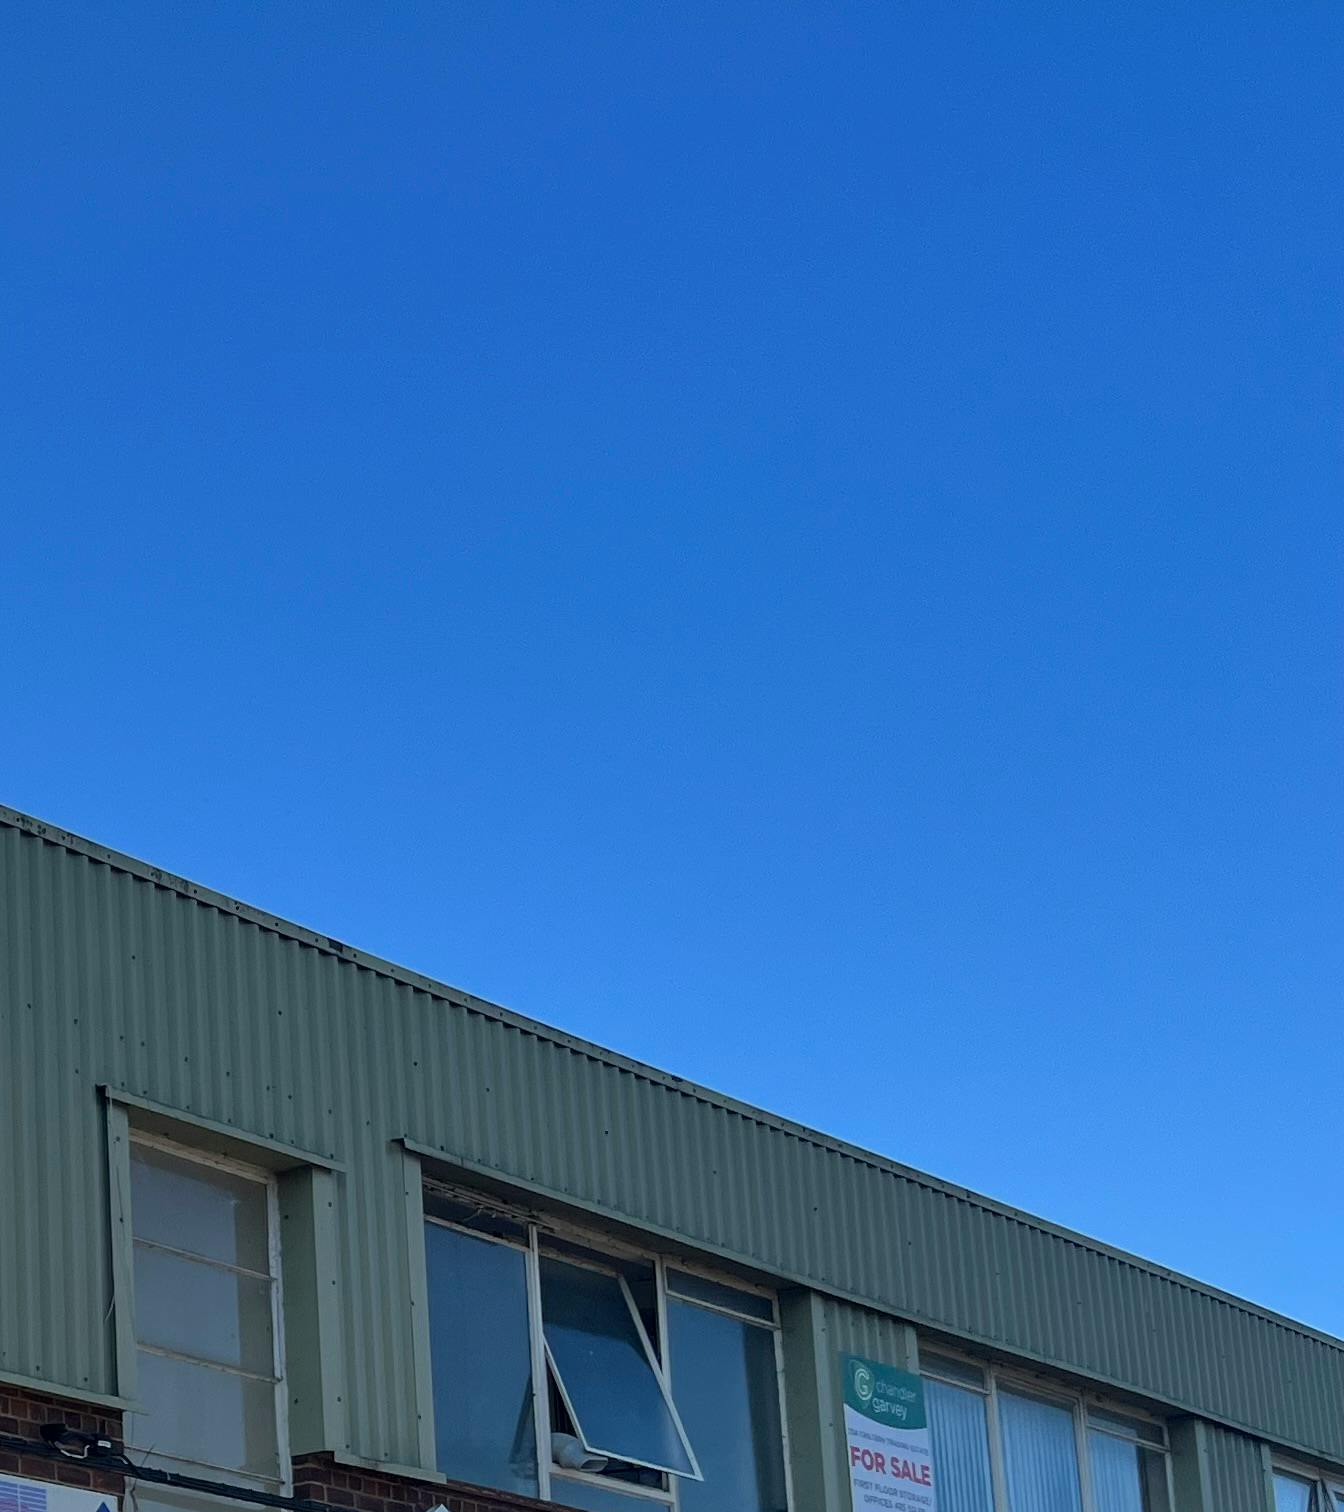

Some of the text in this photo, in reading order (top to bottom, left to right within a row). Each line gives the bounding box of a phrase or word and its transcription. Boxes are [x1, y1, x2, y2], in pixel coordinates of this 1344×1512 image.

[876, 1382, 916, 1402] chandler
[872, 1398, 907, 1421] garvey
[850, 1445, 931, 1487] FOR SALE
[854, 1479, 872, 1490] FIRST
[874, 1483, 897, 1497] FLOOR
[864, 1494, 893, 1508] OFFICES
